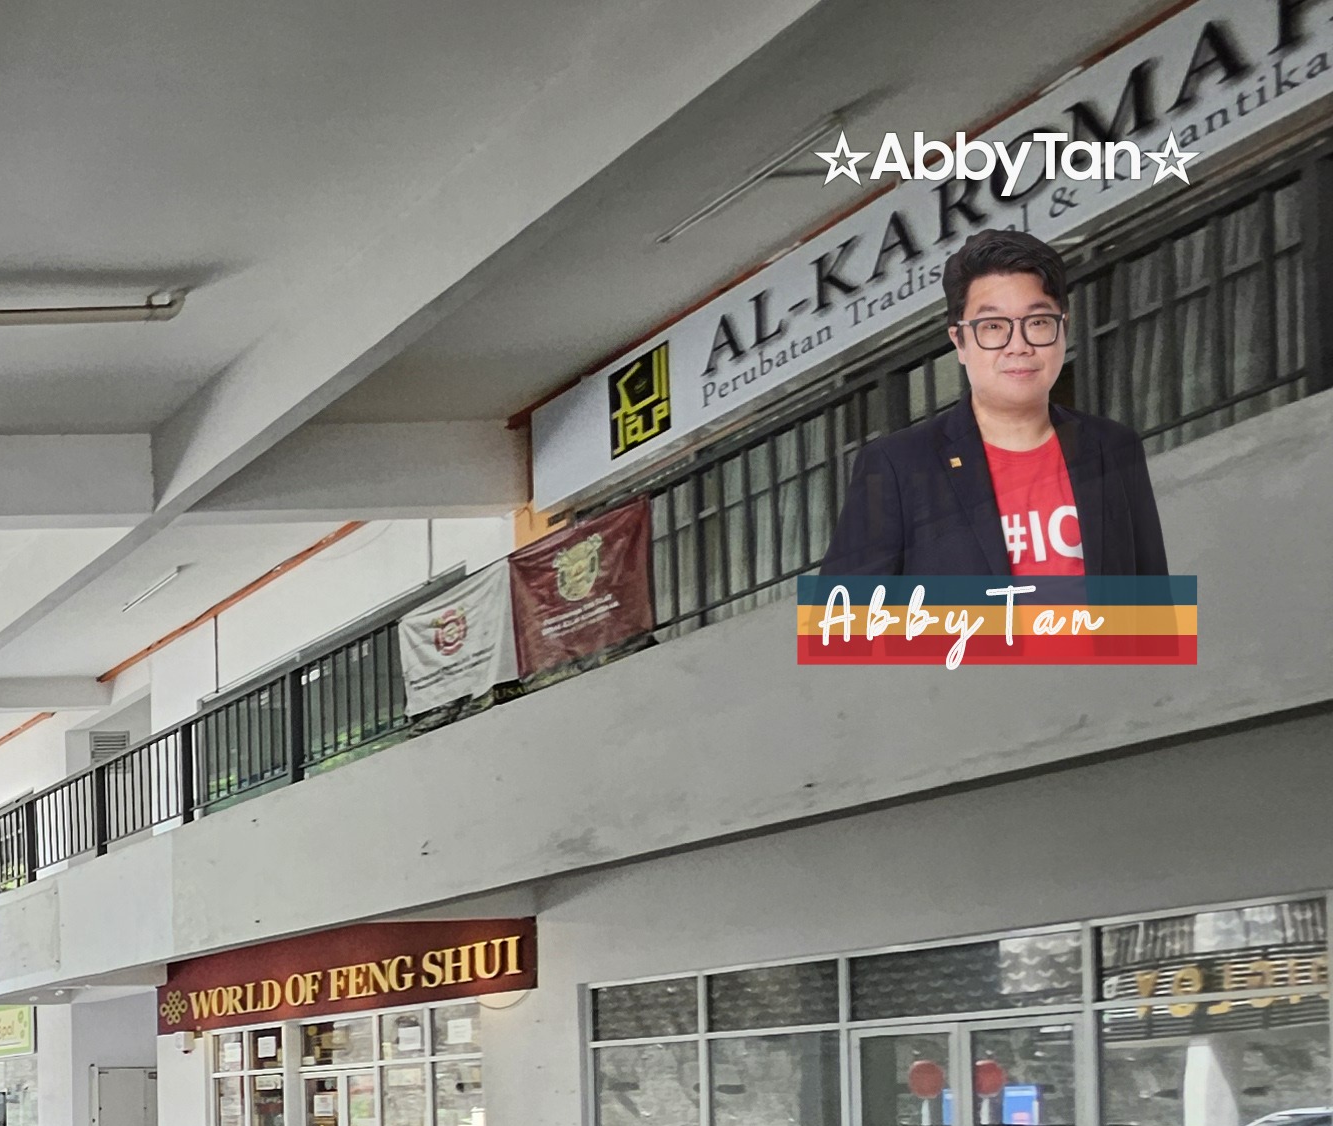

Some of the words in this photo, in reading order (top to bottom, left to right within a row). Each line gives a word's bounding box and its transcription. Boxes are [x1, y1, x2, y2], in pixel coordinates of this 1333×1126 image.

[701, 324, 835, 408] Perubatan
[1049, 186, 1079, 219] &
[189, 978, 282, 1020] WORLD
[285, 971, 323, 1007] OF
[327, 954, 416, 1002] FENG
[421, 935, 524, 989] SHUI
